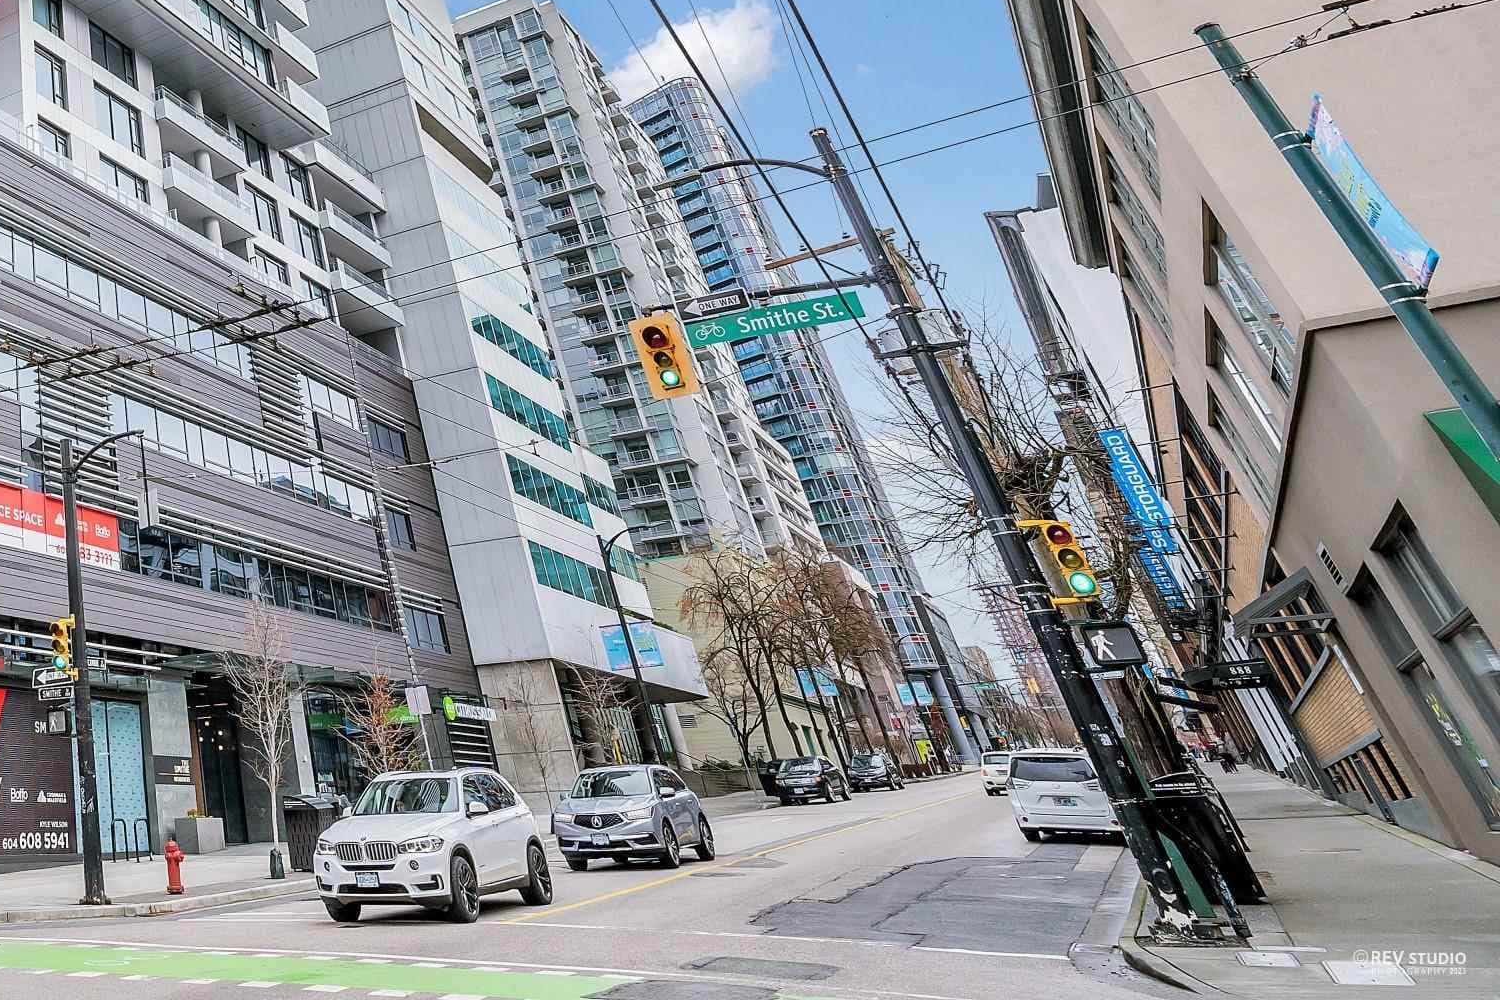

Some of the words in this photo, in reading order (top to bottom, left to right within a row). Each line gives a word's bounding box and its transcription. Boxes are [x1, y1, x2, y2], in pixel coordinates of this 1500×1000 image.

[699, 301, 717, 311] ONE
[719, 296, 739, 306] WAY
[737, 308, 809, 333] Smithe
[813, 302, 844, 320] St.
[1106, 434, 1164, 523] STORGUARD
[13, 507, 44, 527] SPACE
[1229, 665, 1252, 675] 888
[2, 838, 18, 849] 604
[19, 832, 42, 849] 608
[43, 832, 69, 849] 5941
